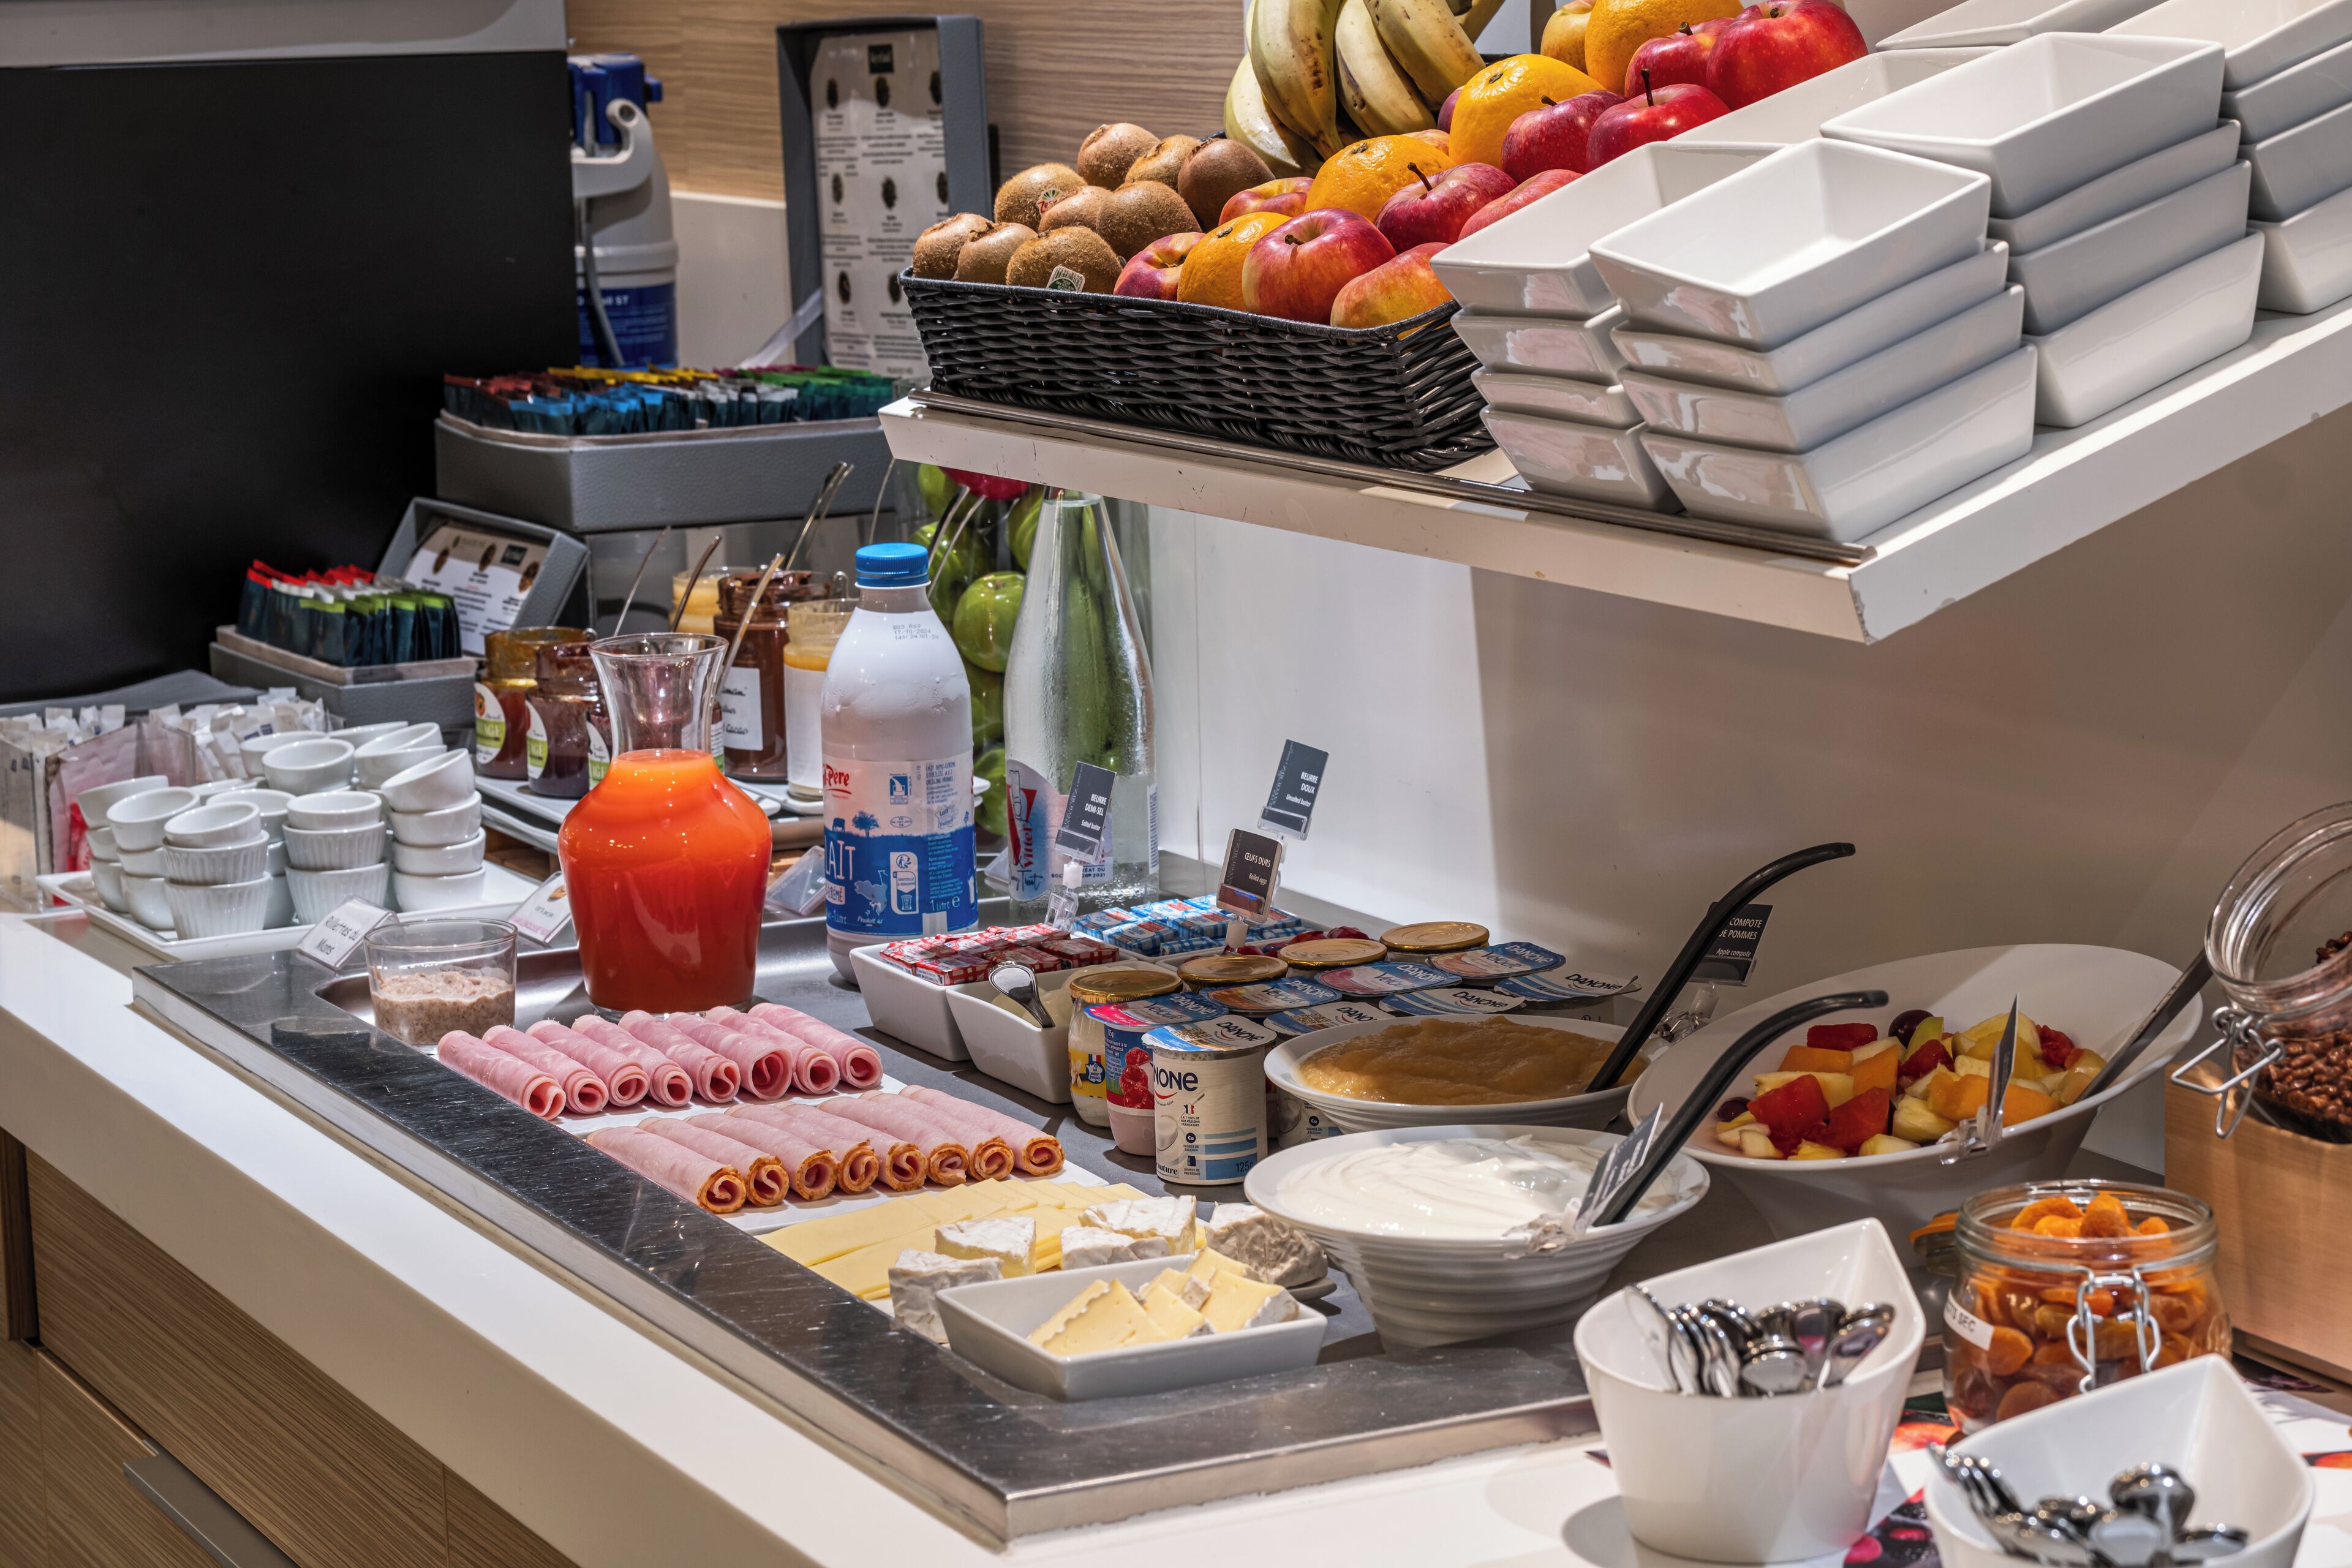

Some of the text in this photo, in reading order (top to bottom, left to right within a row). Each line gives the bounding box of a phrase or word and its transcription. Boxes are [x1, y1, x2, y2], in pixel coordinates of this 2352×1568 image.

[1300, 772, 1318, 783] BEURRE
[1300, 783, 1316, 794] DOUX
[1090, 794, 1107, 805] BEURRE
[1286, 794, 1311, 807] Unsalted butter
[1085, 803, 1104, 816] DEMI-SEL
[1081, 820, 1101, 831] Salted butter
[1022, 827, 1034, 869] Vittel
[1245, 852, 1271, 868] ŒUFS DURS
[1249, 873, 1260, 883] Boiled
[1729, 918, 1762, 928] COMPOTE
[1728, 930, 1757, 940] POMMES
[315, 938, 335, 955] Mans
[1506, 944, 1553, 963] DANONE
[1396, 964, 1447, 982] DANONE
[1289, 980, 1335, 998] DANONE
[1565, 973, 1623, 990] DANONE
[1170, 996, 1216, 1014] DANONE
[1452, 991, 1509, 1008] DANONE
[1336, 1007, 1378, 1021] DANO
[1216, 1022, 1265, 1041] DANONE
[1153, 1065, 1198, 1091] NONE
[1236, 1160, 1254, 1172] 125g
